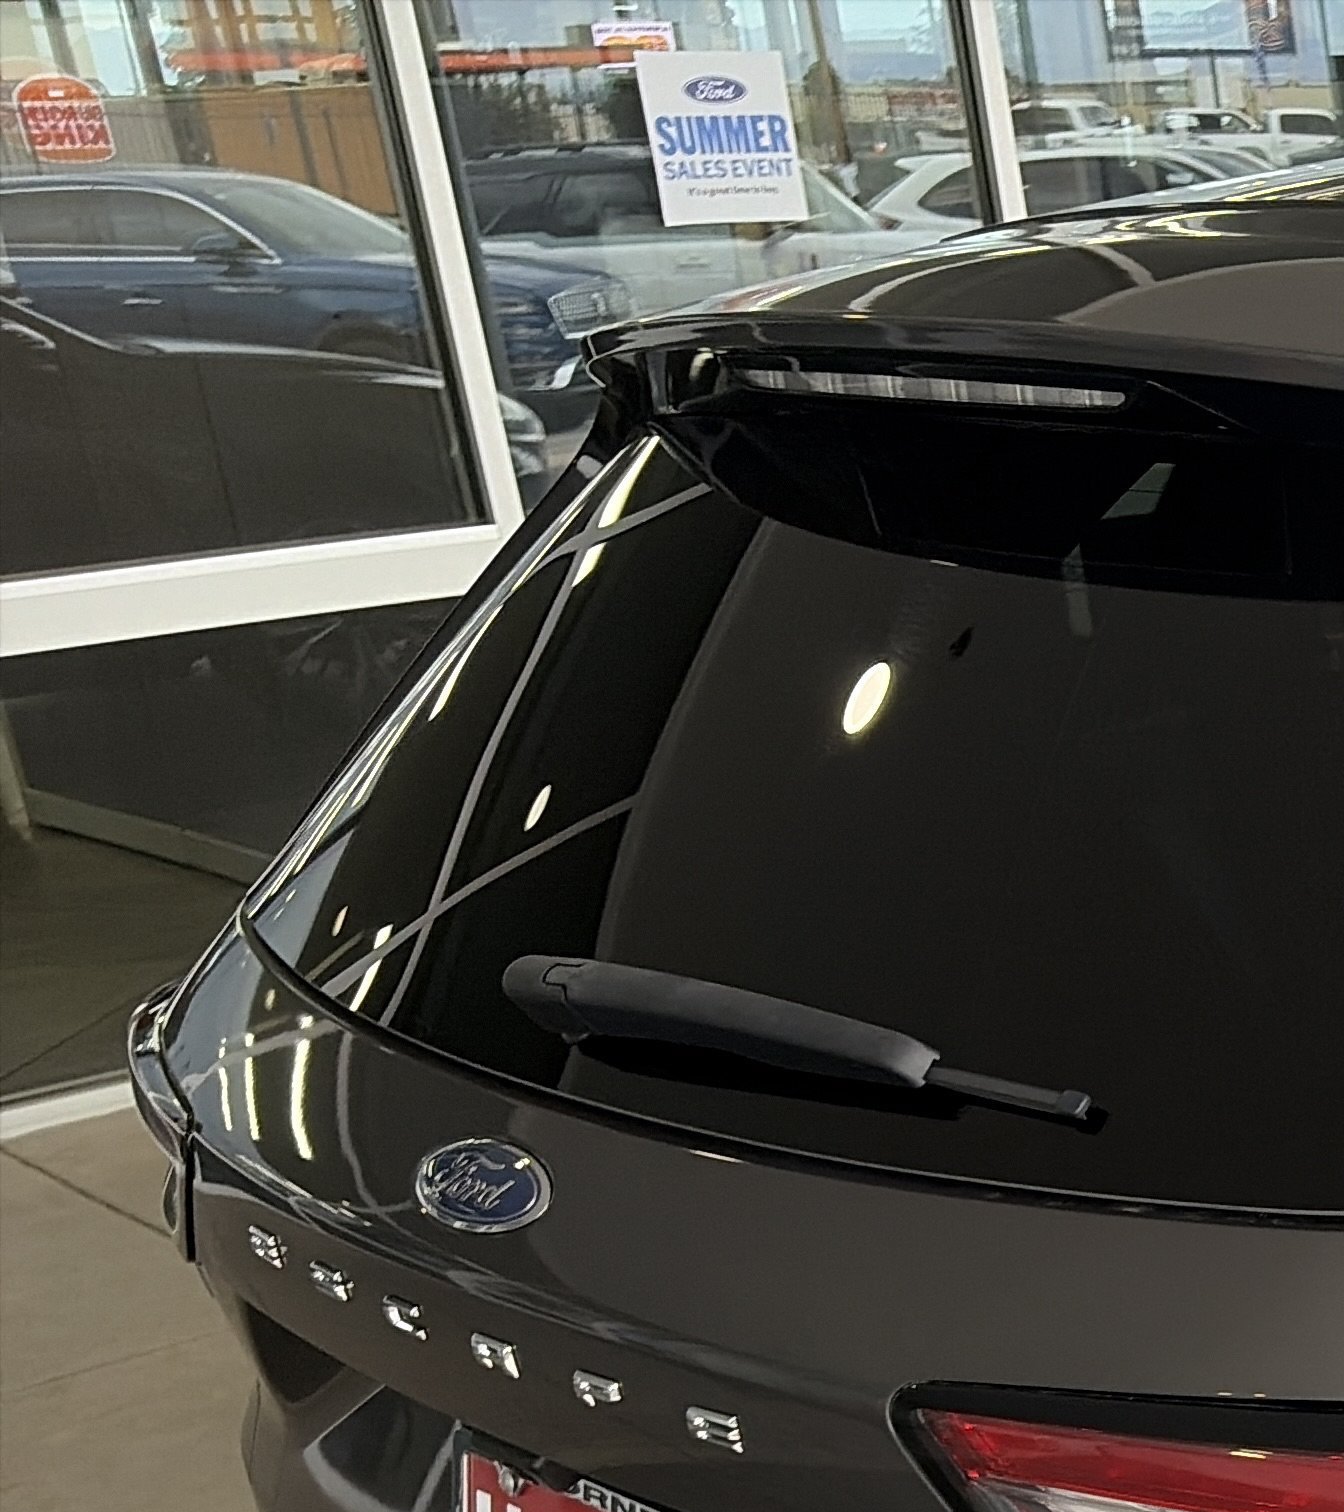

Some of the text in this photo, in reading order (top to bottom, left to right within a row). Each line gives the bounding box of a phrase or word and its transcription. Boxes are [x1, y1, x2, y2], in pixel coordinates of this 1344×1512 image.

[655, 114, 791, 157] SUMMER
[662, 157, 794, 181] SALES EVENT
[429, 1150, 517, 1210] Ford
[248, 1224, 744, 1453] ESCAPE
